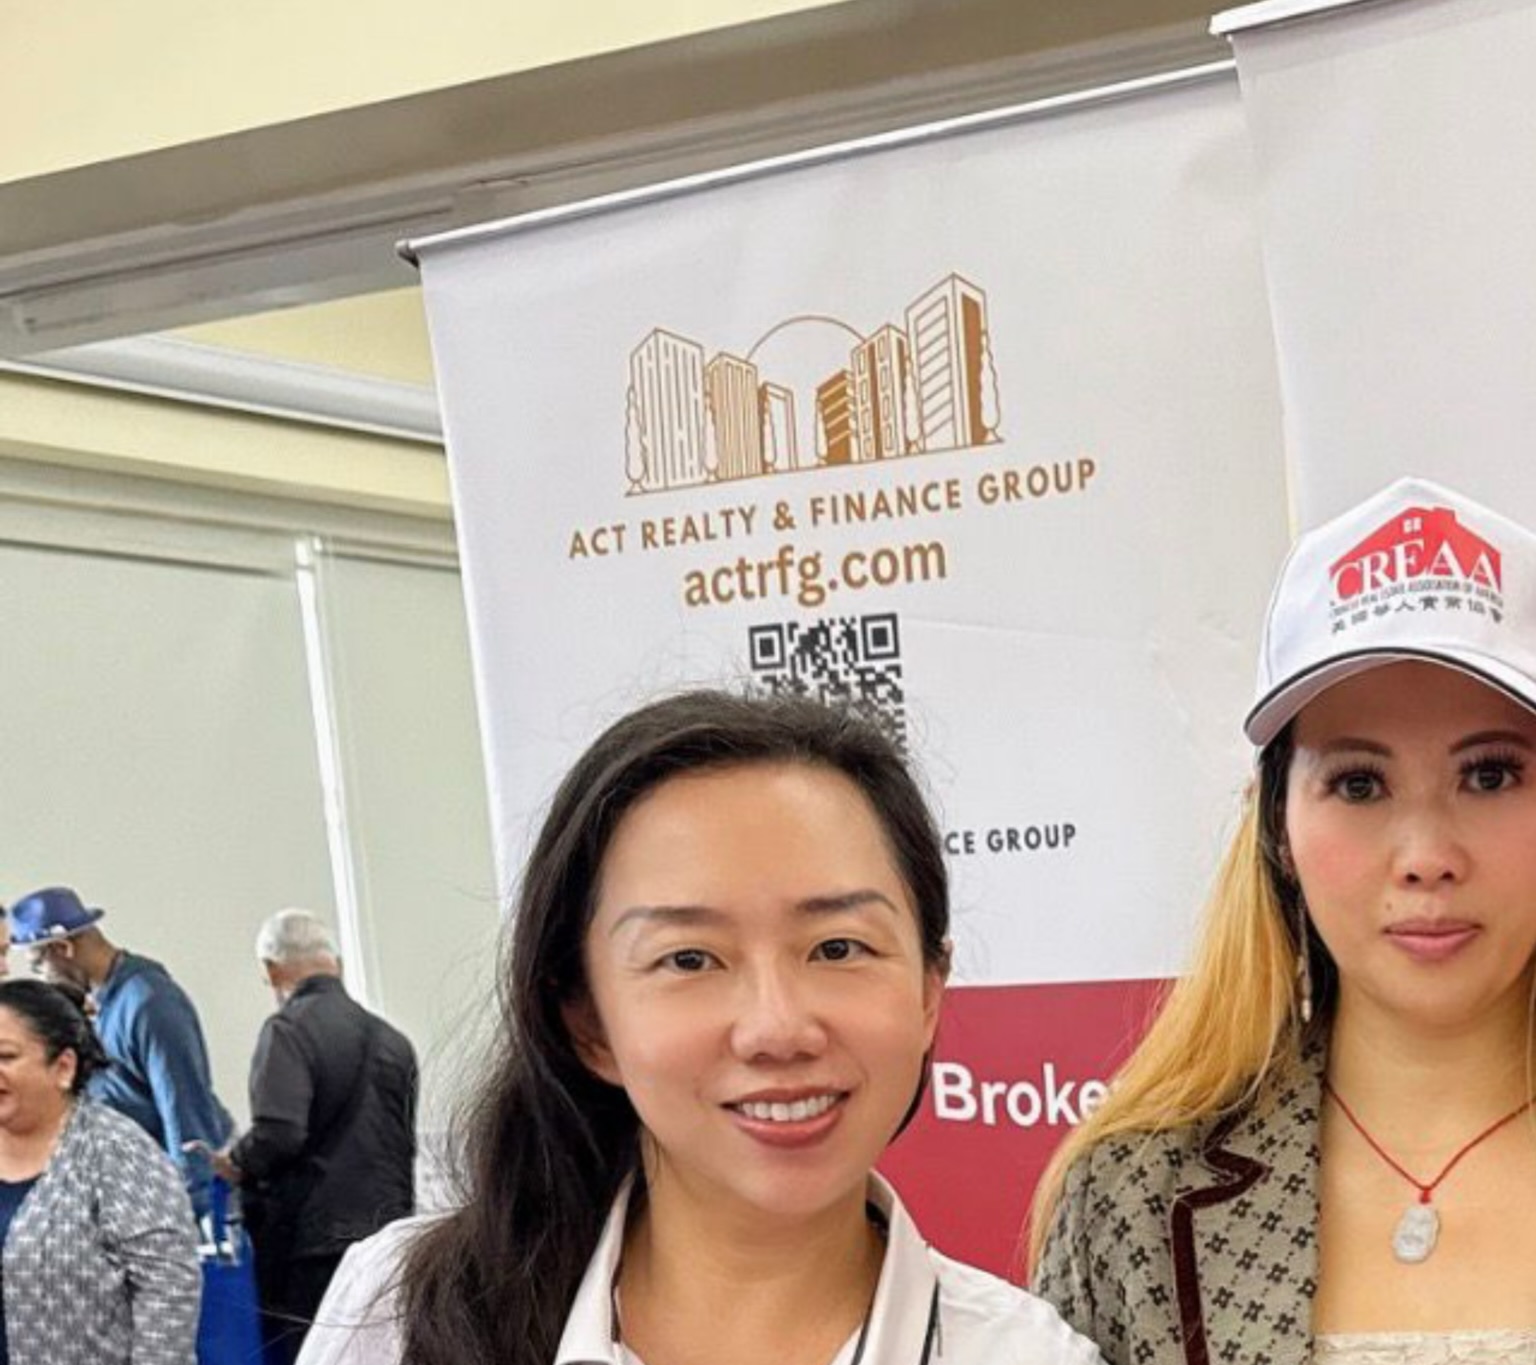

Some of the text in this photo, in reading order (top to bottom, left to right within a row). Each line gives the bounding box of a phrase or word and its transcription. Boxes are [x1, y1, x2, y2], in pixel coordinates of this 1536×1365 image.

[569, 457, 1099, 560] ACT REALTY & FINANCE GROUP
[683, 536, 949, 607] actrfg.com
[1330, 538, 1502, 604] CREAA
[986, 823, 1079, 855] GROUP
